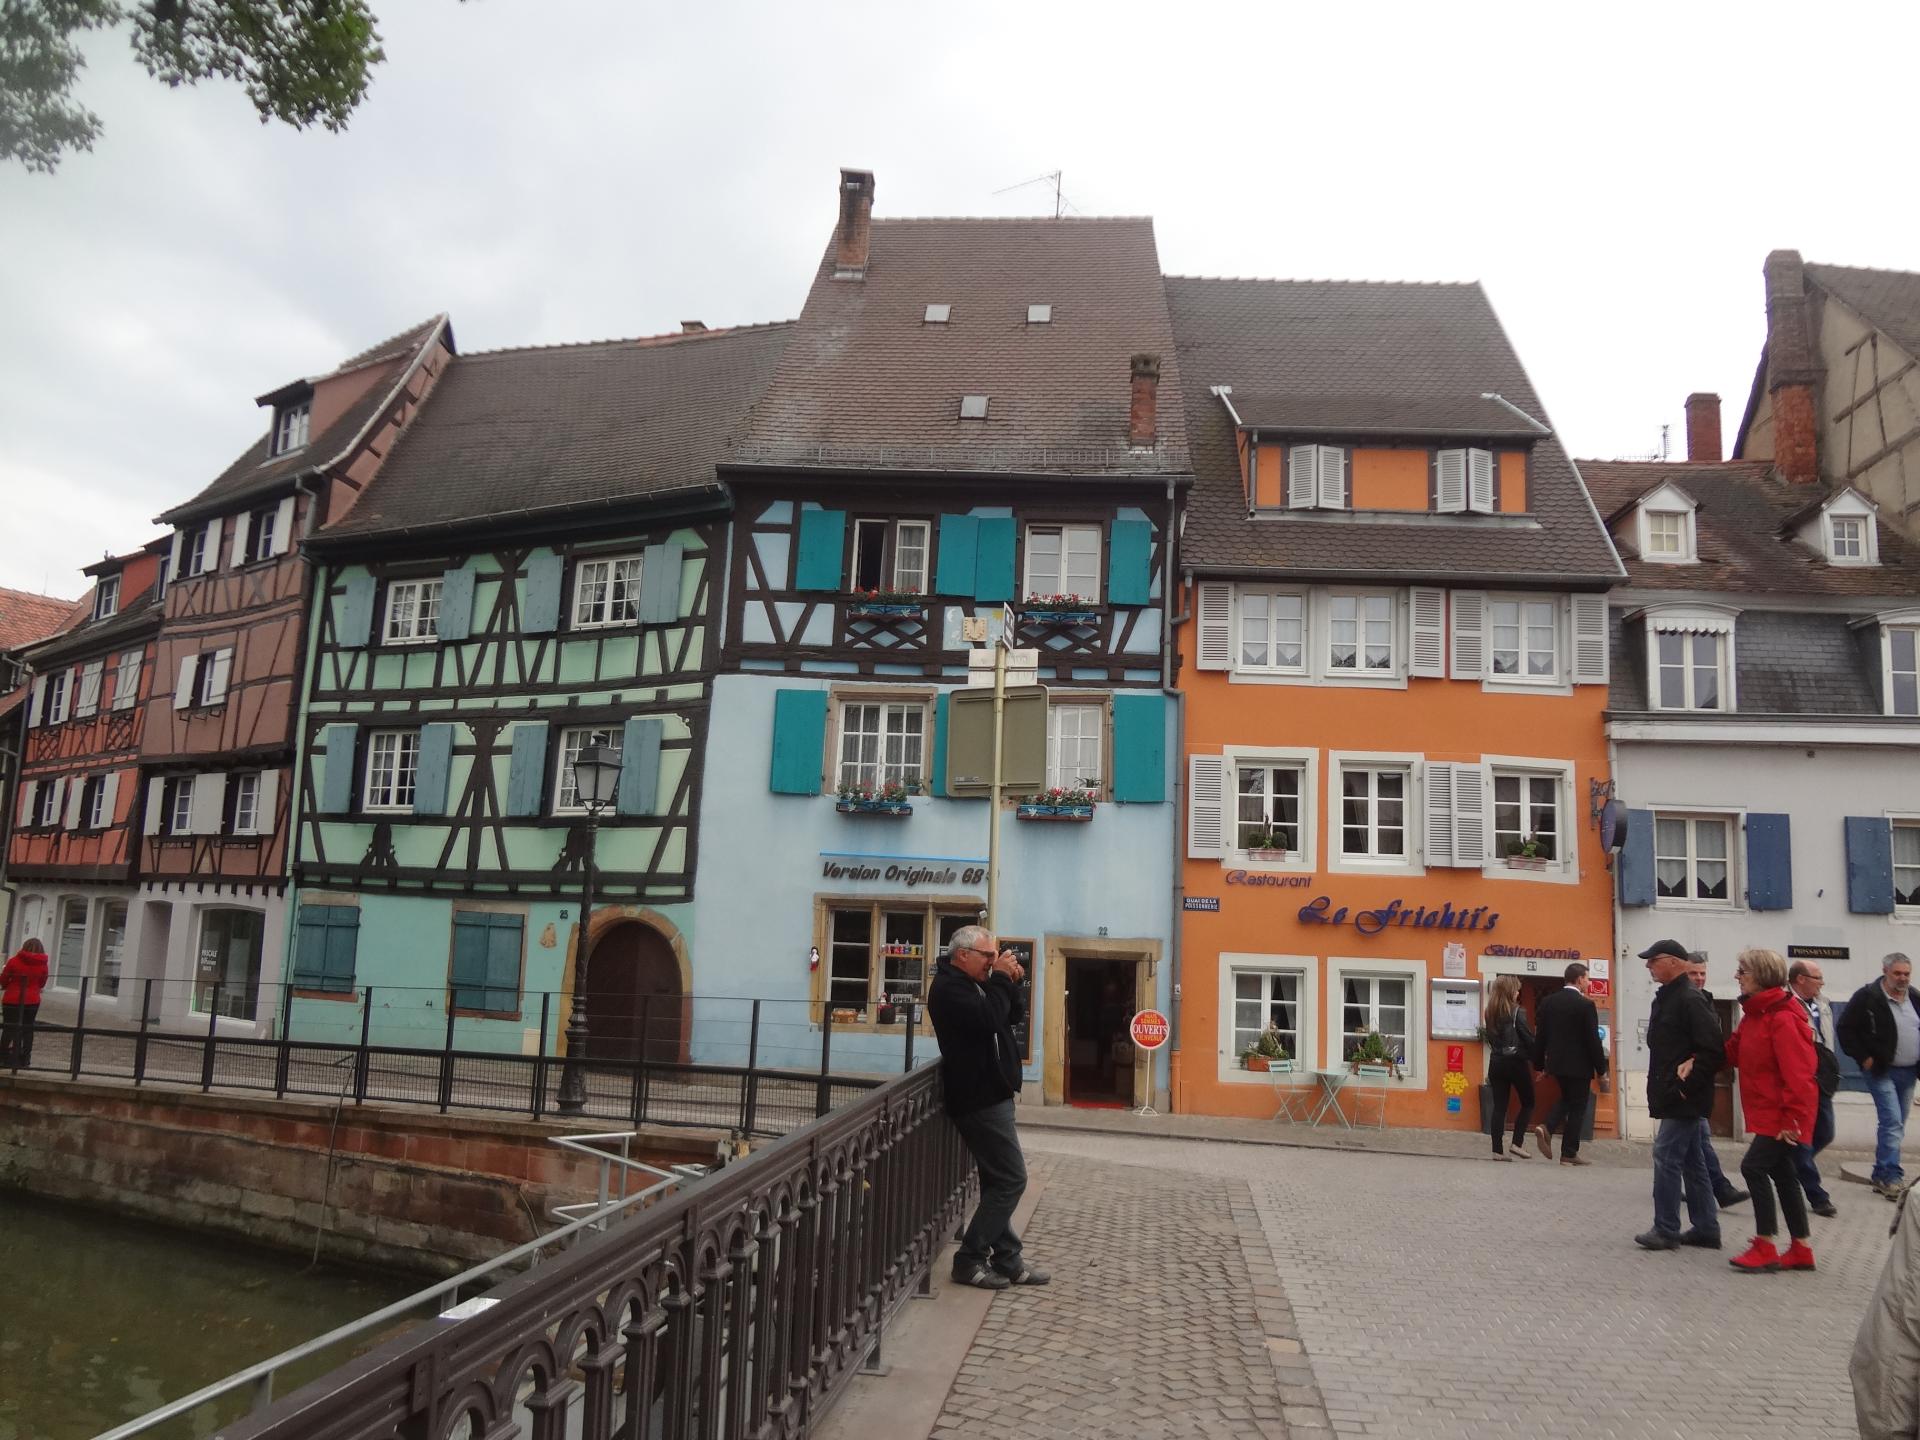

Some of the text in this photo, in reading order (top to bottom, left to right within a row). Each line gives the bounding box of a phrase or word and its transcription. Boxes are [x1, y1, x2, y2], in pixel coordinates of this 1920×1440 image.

[823, 861, 985, 886] Version Originale 68
[1226, 869, 1312, 888] Restaurant
[1298, 896, 1499, 935] Le Frichti's
[1098, 926, 1108, 936] 22
[1485, 944, 1580, 960] Bistronomie
[1133, 1023, 1168, 1036] OUVERTS
